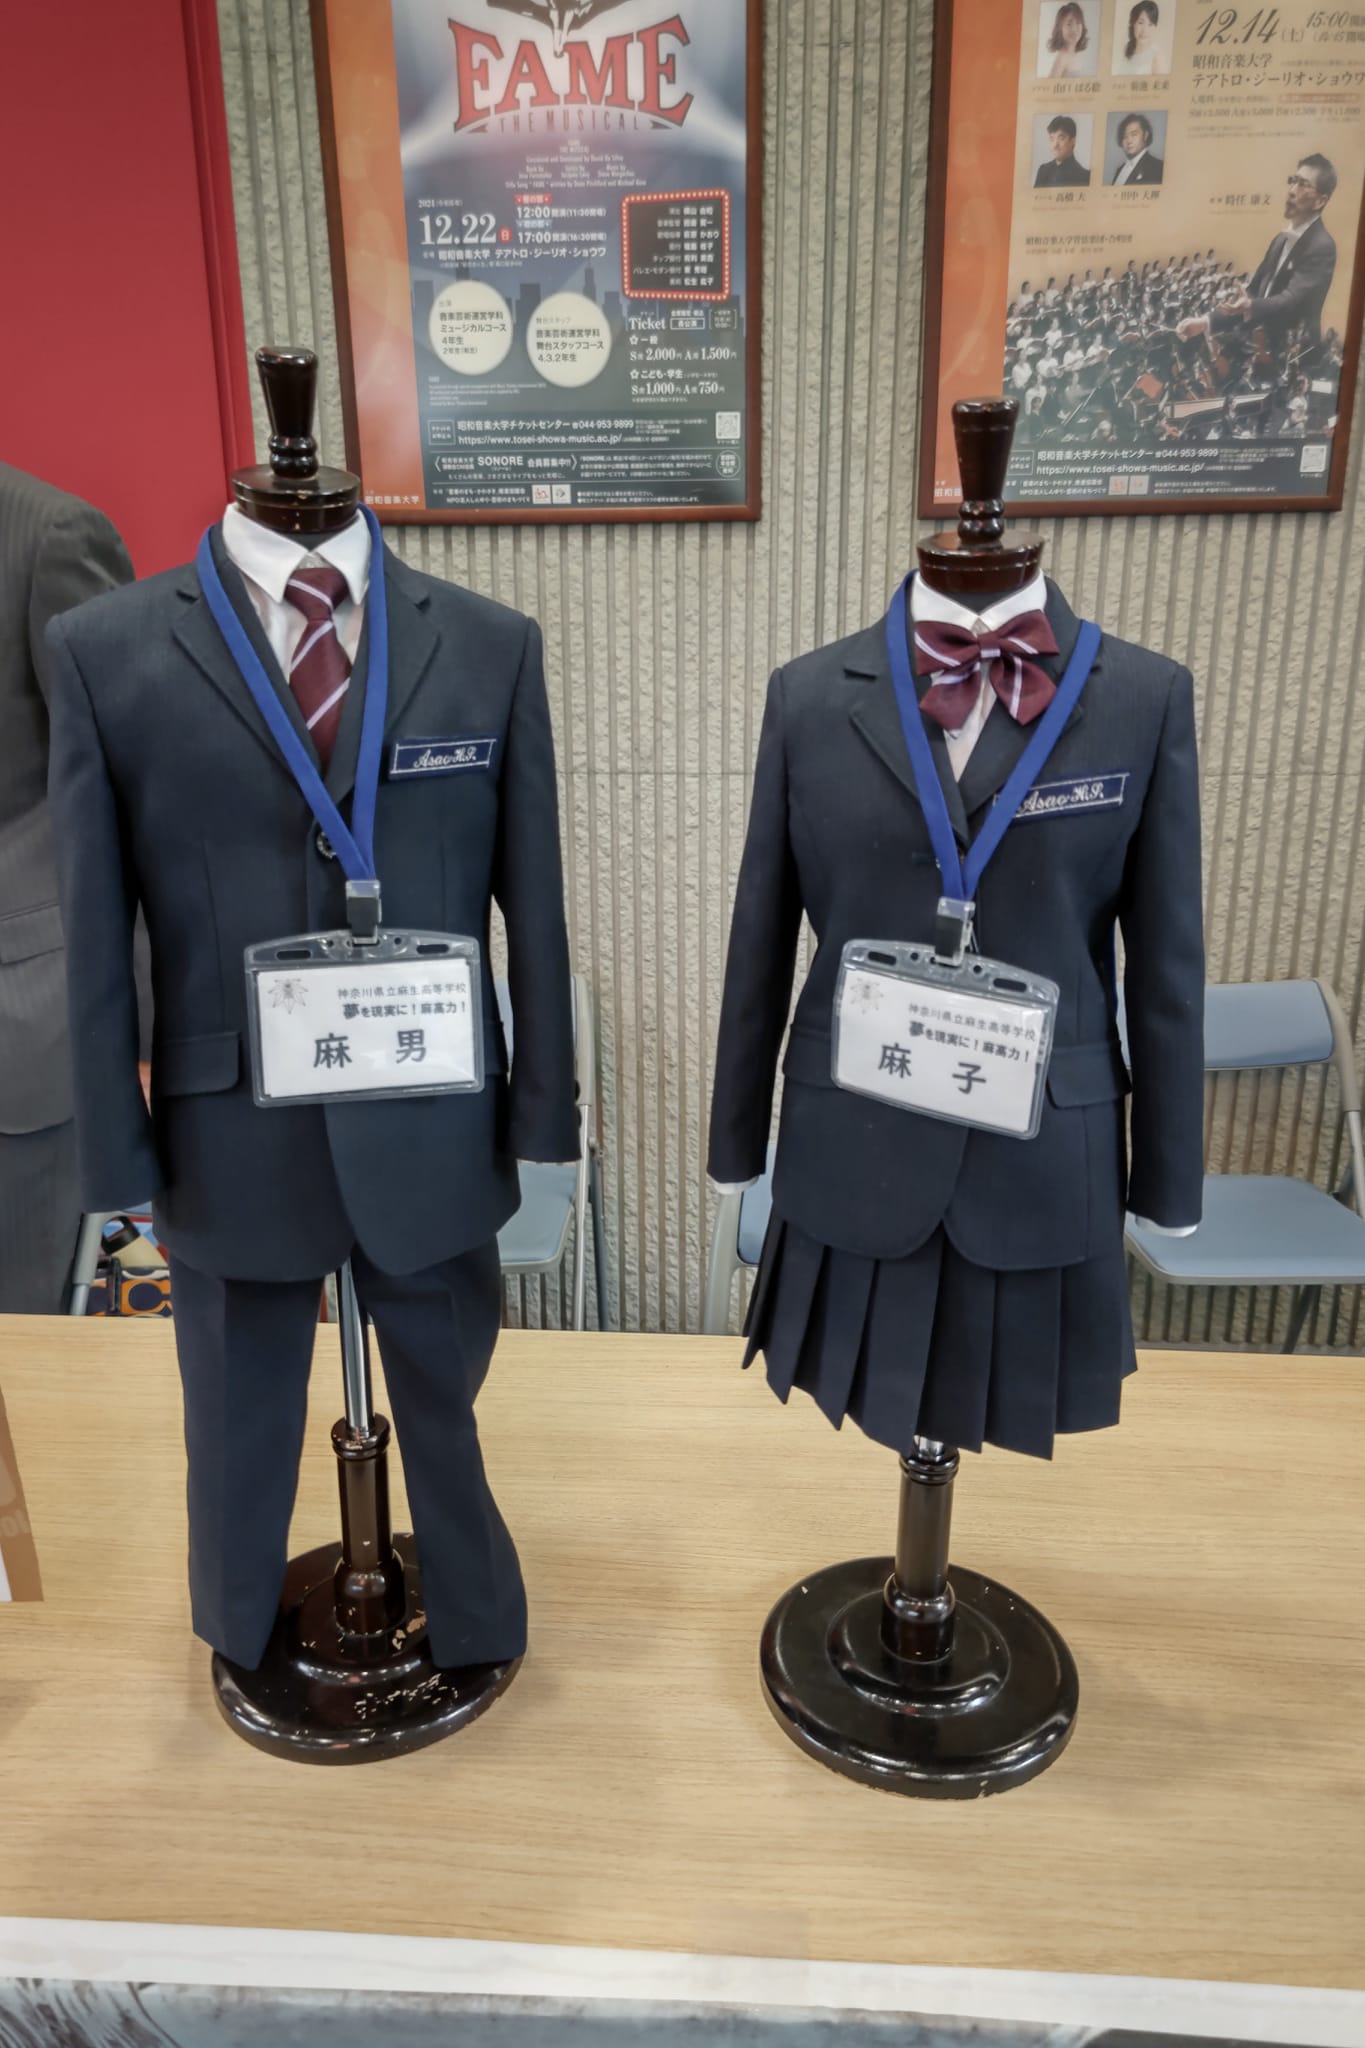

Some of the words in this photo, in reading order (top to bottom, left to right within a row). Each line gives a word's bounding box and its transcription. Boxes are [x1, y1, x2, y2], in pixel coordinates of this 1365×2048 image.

[1195, 9, 1280, 45] 12.14
[1192, 53, 1272, 69] 昭和音楽大学
[448, 14, 694, 133] FAME
[1192, 71, 1365, 88] テアトロ・ジーリオ・ショウワ
[500, 112, 533, 133] THE
[546, 108, 639, 133] MUSICAL
[419, 213, 497, 246] 12.22
[438, 250, 491, 260] 昭和音楽大学
[495, 248, 607, 258] テアトロ・ジーリオ・ショウワ
[440, 323, 507, 333] ミュージカルコース
[628, 317, 666, 330] Ticket
[442, 336, 464, 345] 4年生
[536, 341, 604, 350] 舞台スタッフコース
[457, 420, 570, 431] 昭和音楽大学チケットセンター
[458, 433, 623, 445] https://www.tosei-showa-music.ac.jp/
[478, 456, 524, 466] SONORE
[1037, 449, 1152, 461] 昭和音楽大学チケットセンター
[365, 495, 419, 504] 昭和音楽大学
[338, 983, 467, 999] 神奈川県立麻生高等学校
[908, 1003, 1037, 1042] 神奈川県立麻生高等学校
[313, 1032, 353, 1069] 麻
[395, 1029, 427, 1064] 男
[878, 1042, 912, 1078] 麻
[952, 1062, 986, 1094] 子
